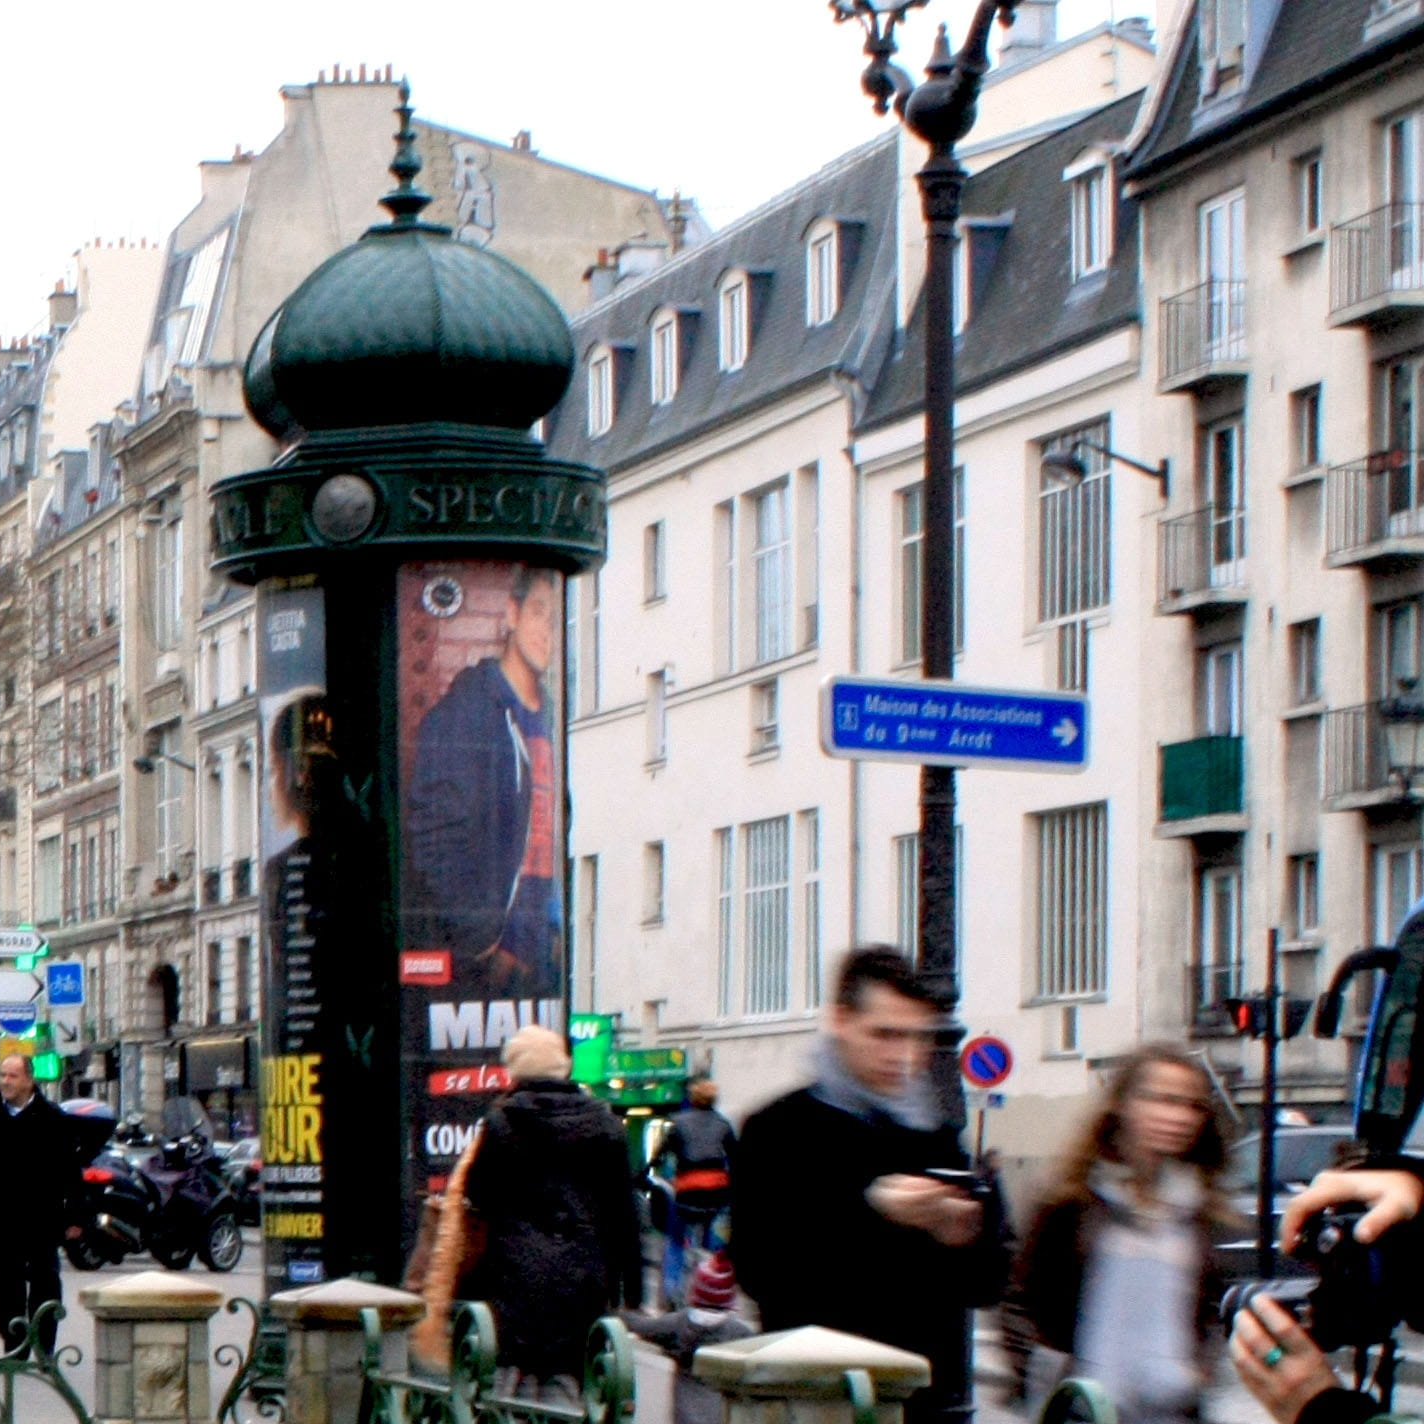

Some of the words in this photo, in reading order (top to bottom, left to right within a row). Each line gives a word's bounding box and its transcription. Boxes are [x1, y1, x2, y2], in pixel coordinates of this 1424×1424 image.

[865, 694, 919, 716] Maison
[922, 699, 948, 720] des
[951, 702, 1043, 725] Associations
[864, 723, 887, 743] du
